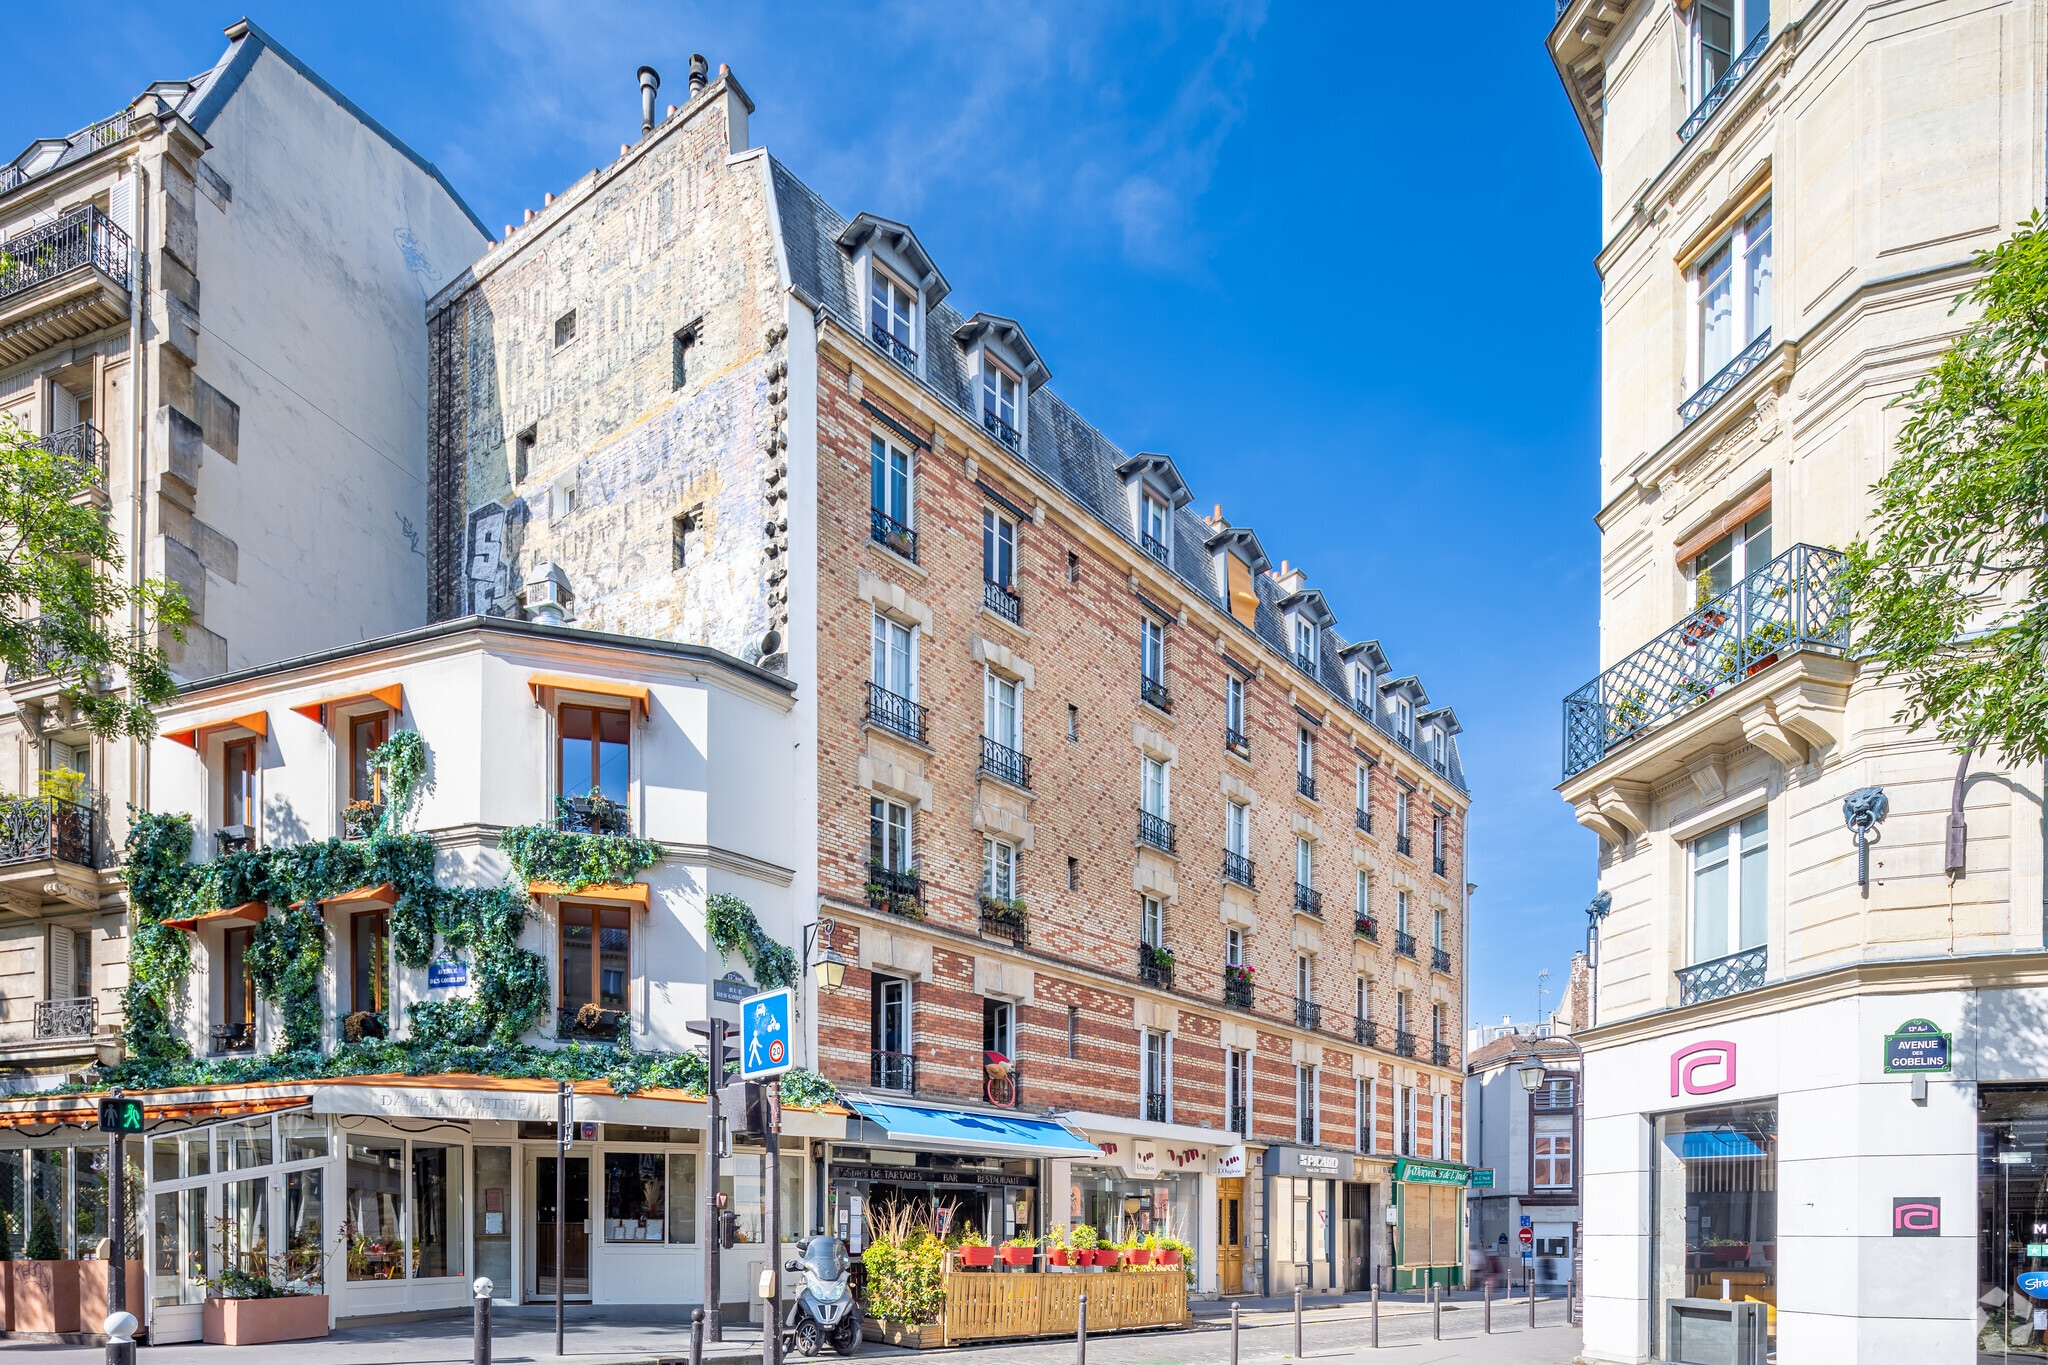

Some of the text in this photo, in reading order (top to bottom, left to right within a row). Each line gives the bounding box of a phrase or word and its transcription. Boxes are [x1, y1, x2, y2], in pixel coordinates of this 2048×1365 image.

[728, 987, 743, 995] RUE
[1897, 1040, 1939, 1050] AVENUE
[772, 1047, 780, 1056] 20
[1892, 1056, 1944, 1066] GOBELINS
[381, 1094, 527, 1111] DAME AUGUSTINE
[1307, 1155, 1339, 1168] PICARD
[884, 1170, 923, 1180] TARTARES
[943, 1173, 958, 1182] BAR
[977, 1174, 1019, 1185] RESTAURANT
